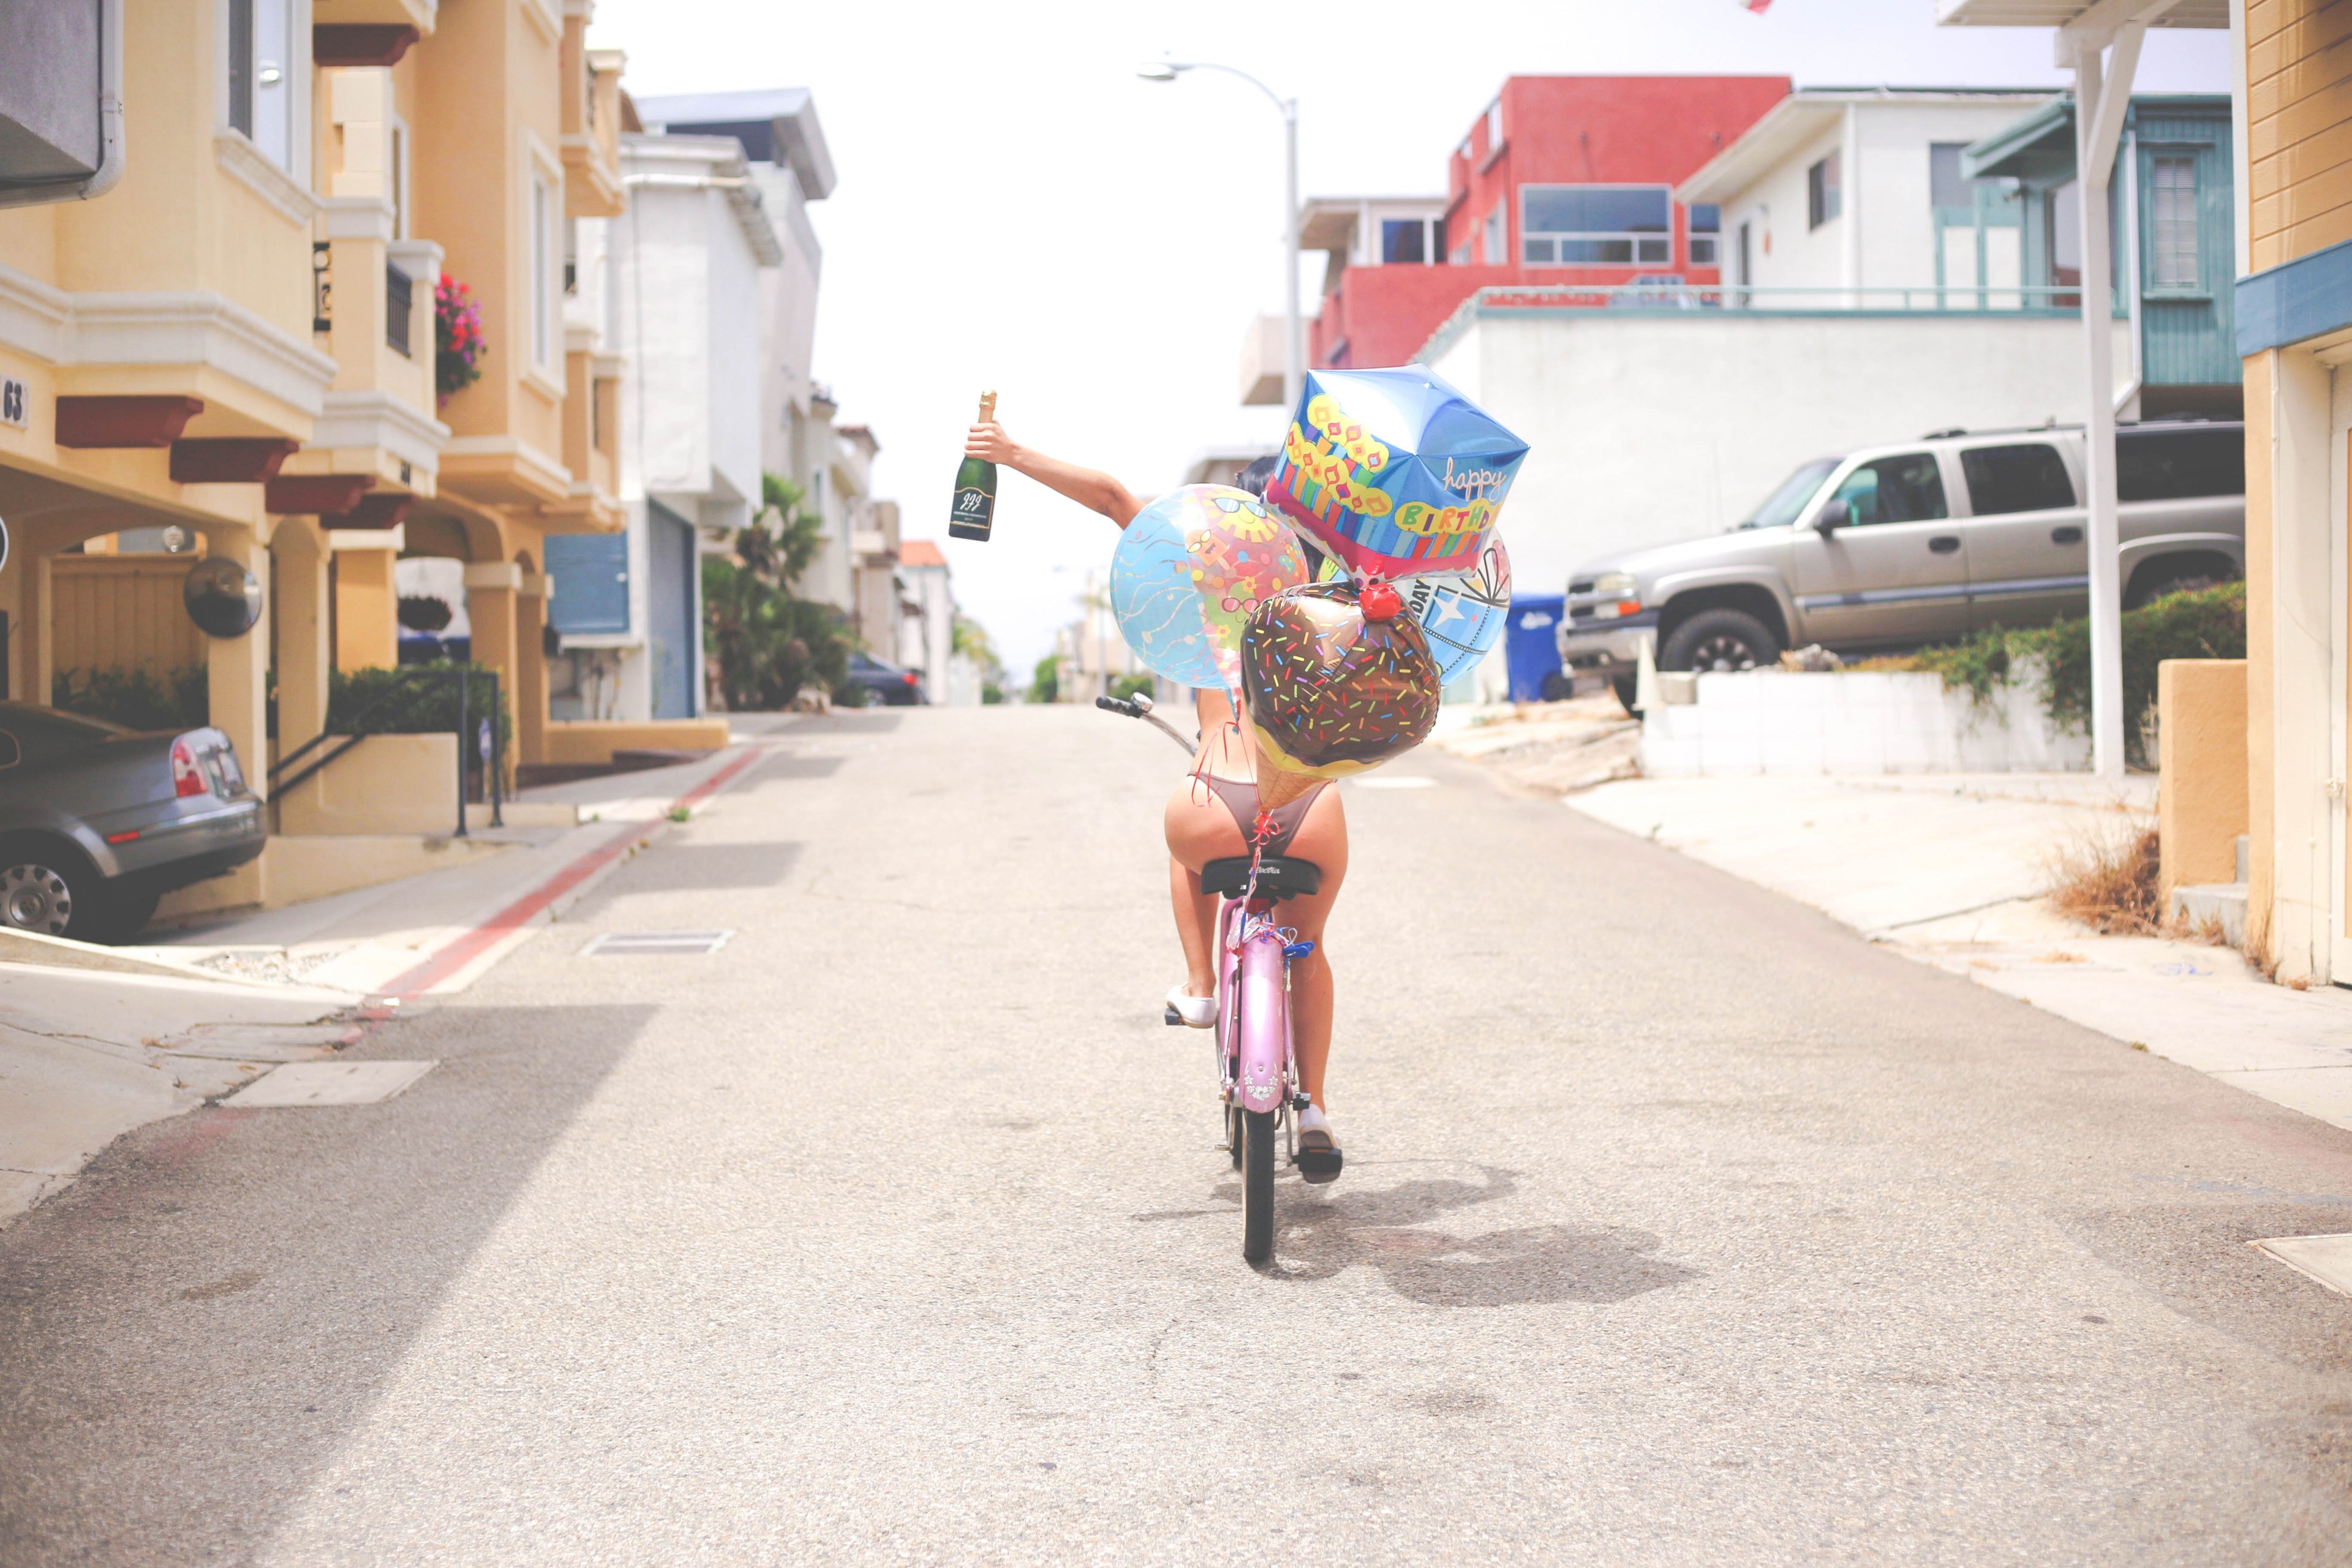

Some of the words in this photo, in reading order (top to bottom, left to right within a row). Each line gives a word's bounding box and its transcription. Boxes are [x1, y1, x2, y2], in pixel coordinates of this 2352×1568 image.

[4, 380, 22, 421] 63
[1442, 456, 1507, 502] happy
[1409, 578, 1431, 619] DAY
